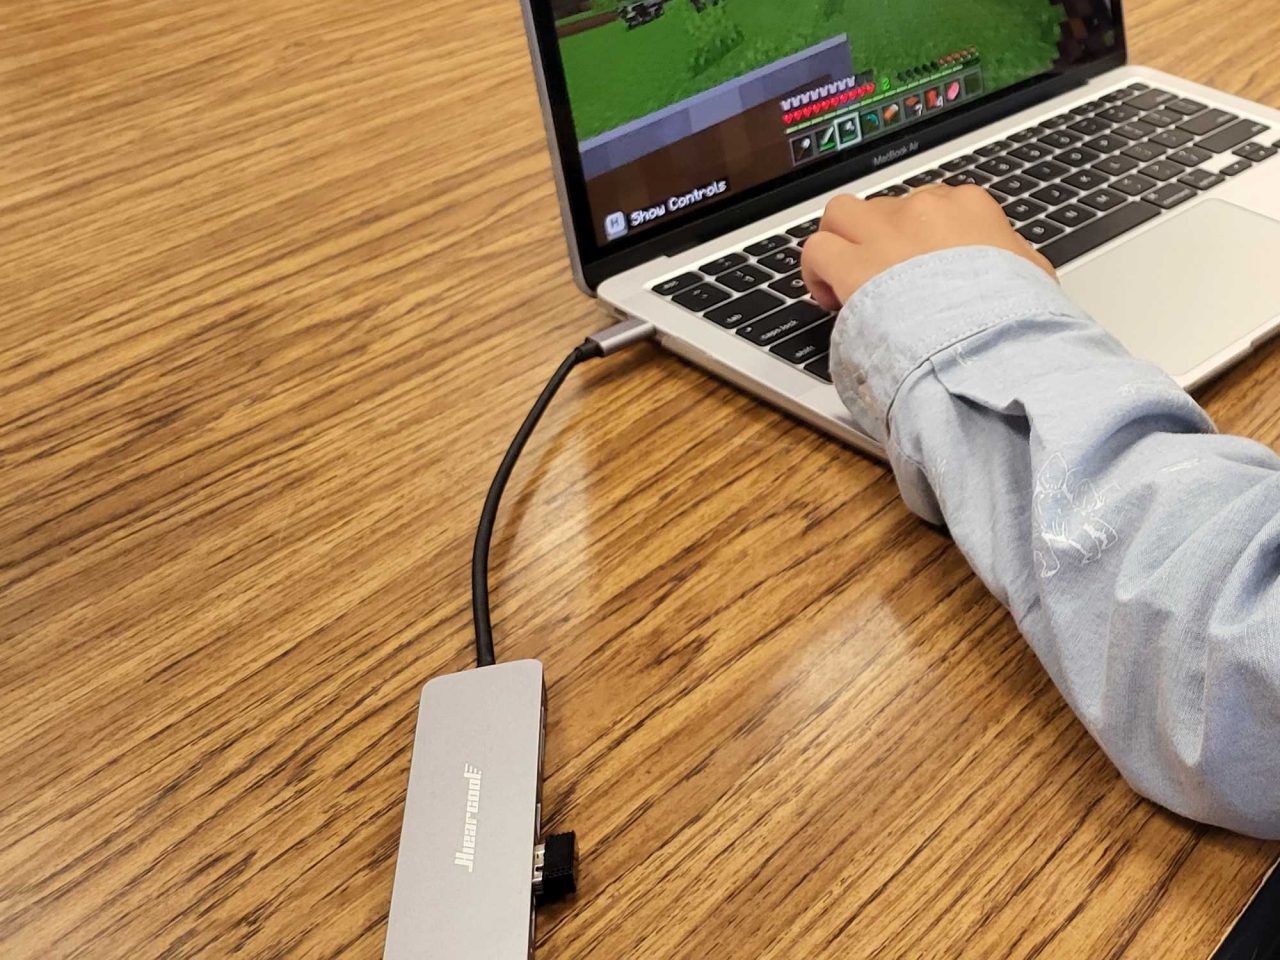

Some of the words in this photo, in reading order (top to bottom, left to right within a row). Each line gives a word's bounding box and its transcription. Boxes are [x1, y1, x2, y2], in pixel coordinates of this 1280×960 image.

[881, 78, 891, 90] 2
[629, 204, 666, 227] Show
[668, 180, 727, 212] Controls
